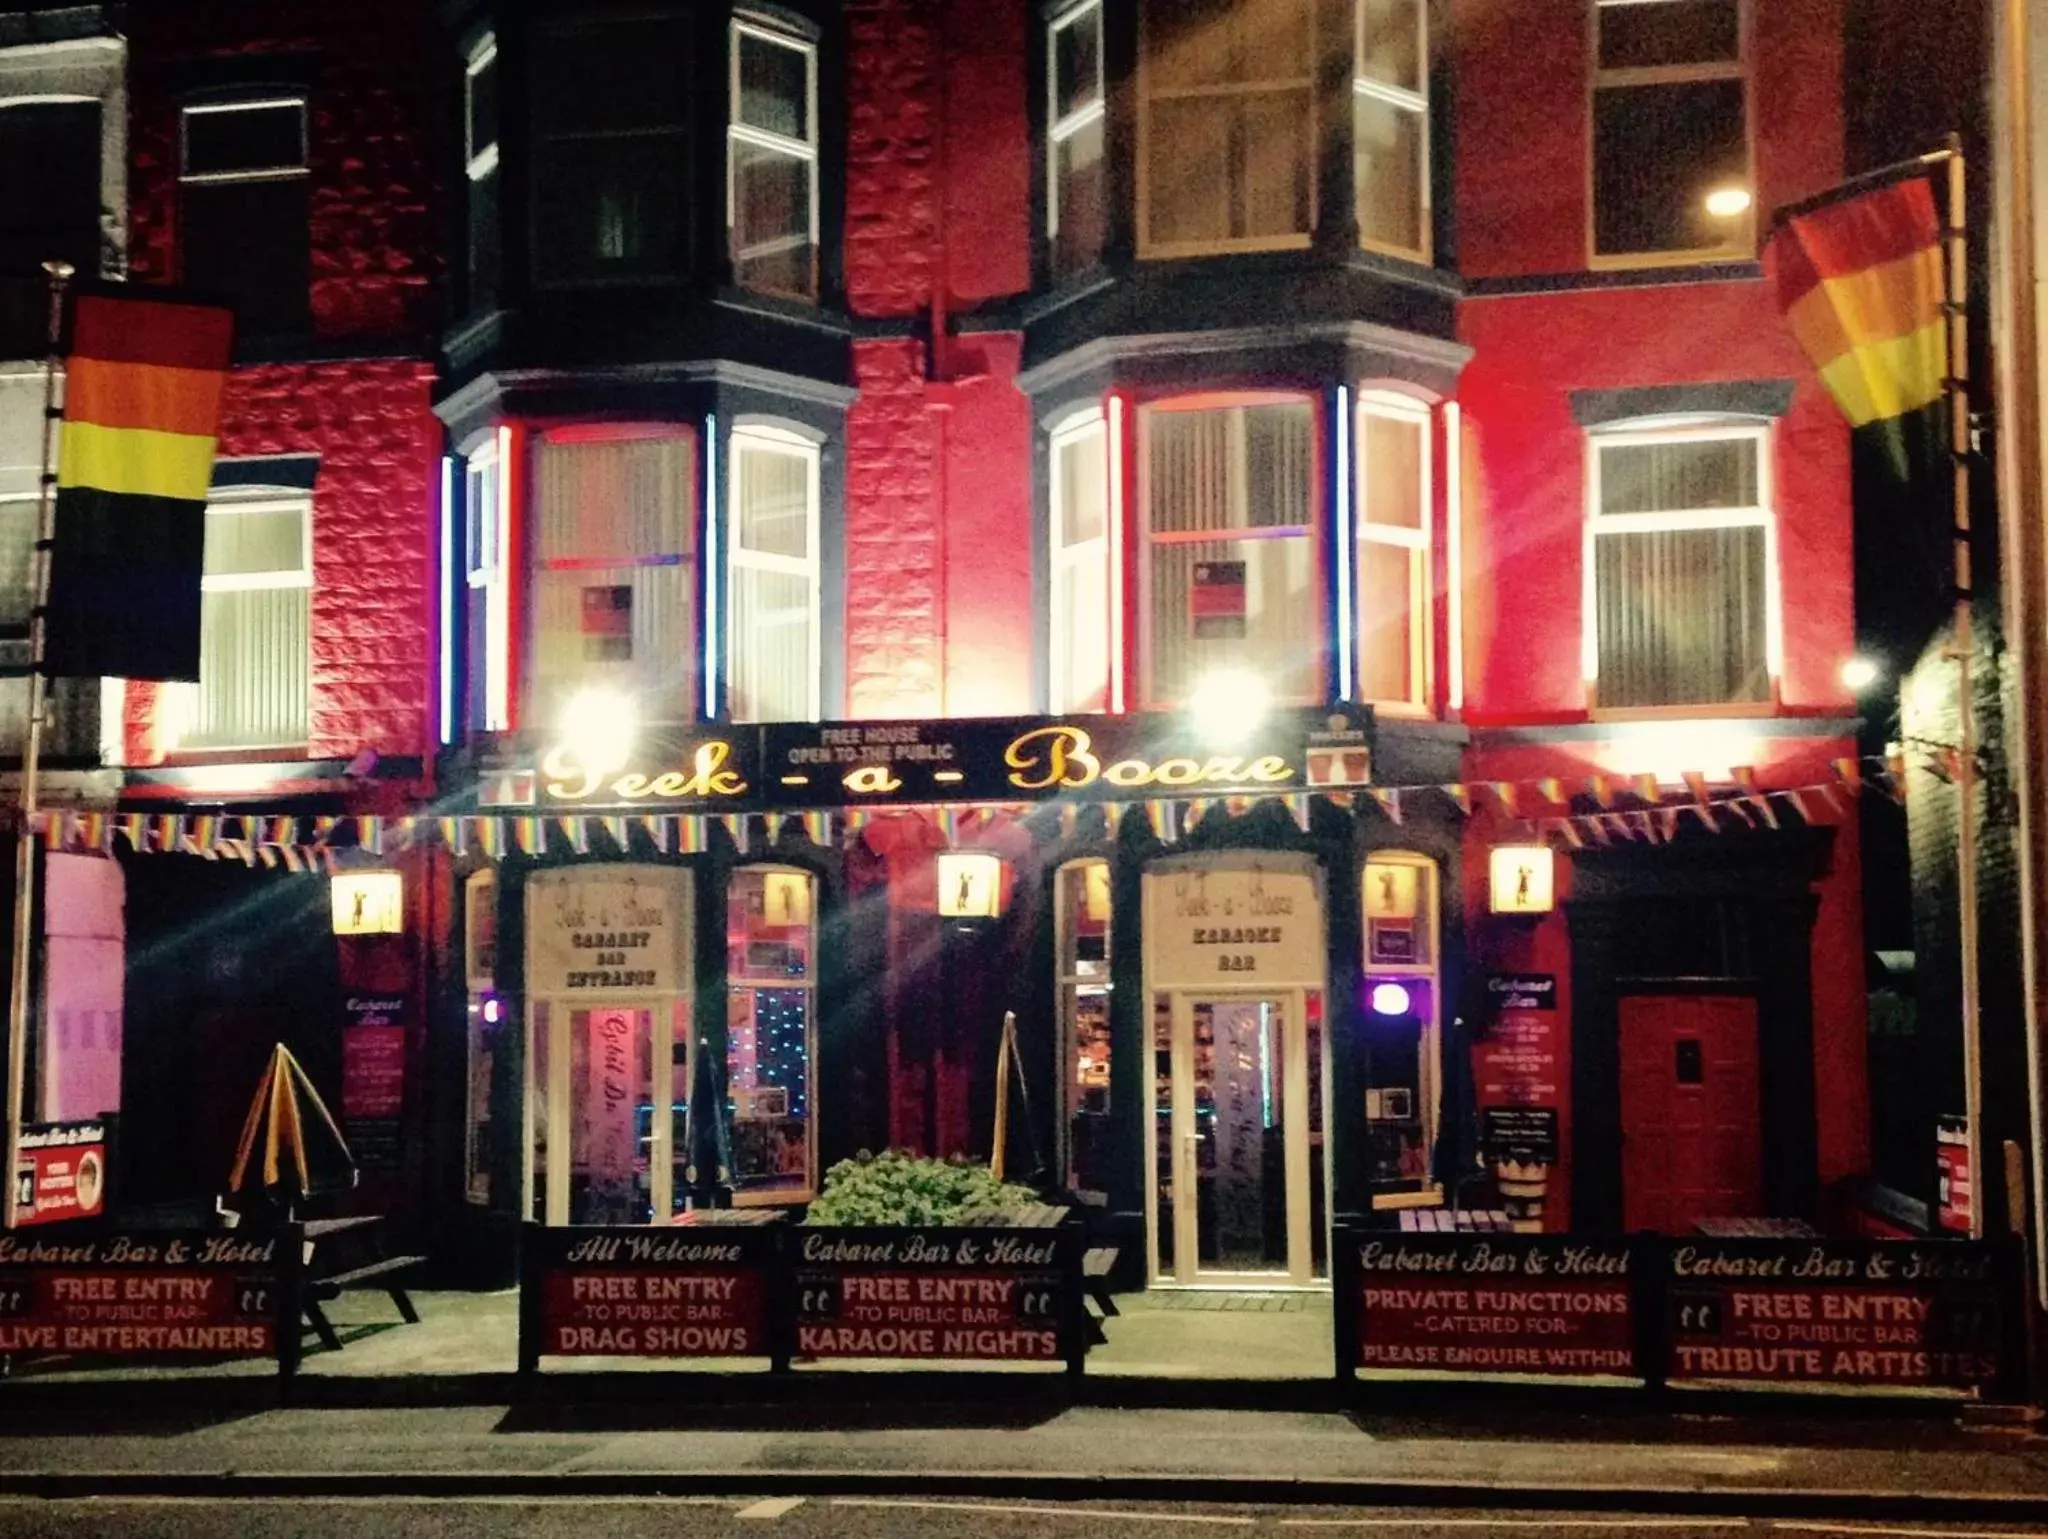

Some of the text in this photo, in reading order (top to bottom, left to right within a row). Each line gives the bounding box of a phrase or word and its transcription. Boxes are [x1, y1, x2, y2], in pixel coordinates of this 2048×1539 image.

[822, 727, 919, 745] FREE HOUSE
[542, 739, 748, 799] Peek
[1003, 726, 1293, 788] Booze
[788, 748, 831, 764] OPEN
[895, 744, 953, 761] PUBLIC
[0, 1236, 276, 1264] Cabaret Bar & Hotel
[568, 1235, 743, 1263] All Welcome
[803, 1233, 1057, 1265] Cabaret Bar & Hotel
[1360, 1241, 1632, 1274] Cabaret Bar & Hotel
[1673, 1246, 1784, 1276] Cabaret
[1792, 1247, 1856, 1277] Bar
[1865, 1251, 1896, 1279] &
[53, 1278, 213, 1300] FREE ENTRY
[573, 1277, 737, 1300] FREE ENTRY
[842, 1278, 910, 1301] FREE
[918, 1278, 1016, 1302] ENTRY
[96, 1305, 158, 1320] PUBLIC
[616, 1304, 681, 1321] PUBLIC
[1363, 1288, 1628, 1314] PRIVATE FUNCTIONS
[1733, 1292, 1932, 1321] FREE ENTRY
[888, 1306, 955, 1323] PUBLIC
[0, 1326, 266, 1350] LIVE ENTERTAINERS
[560, 1327, 748, 1350] DRAG SHOWS
[799, 1327, 1058, 1354] KARAOKE NIGHTS
[1788, 1325, 1867, 1343] PUBLIC
[1363, 1344, 1633, 1367] PLEASE ENQUIRE WITHIN
[1676, 1346, 1996, 1378] TRIBUTE ARTISTES
